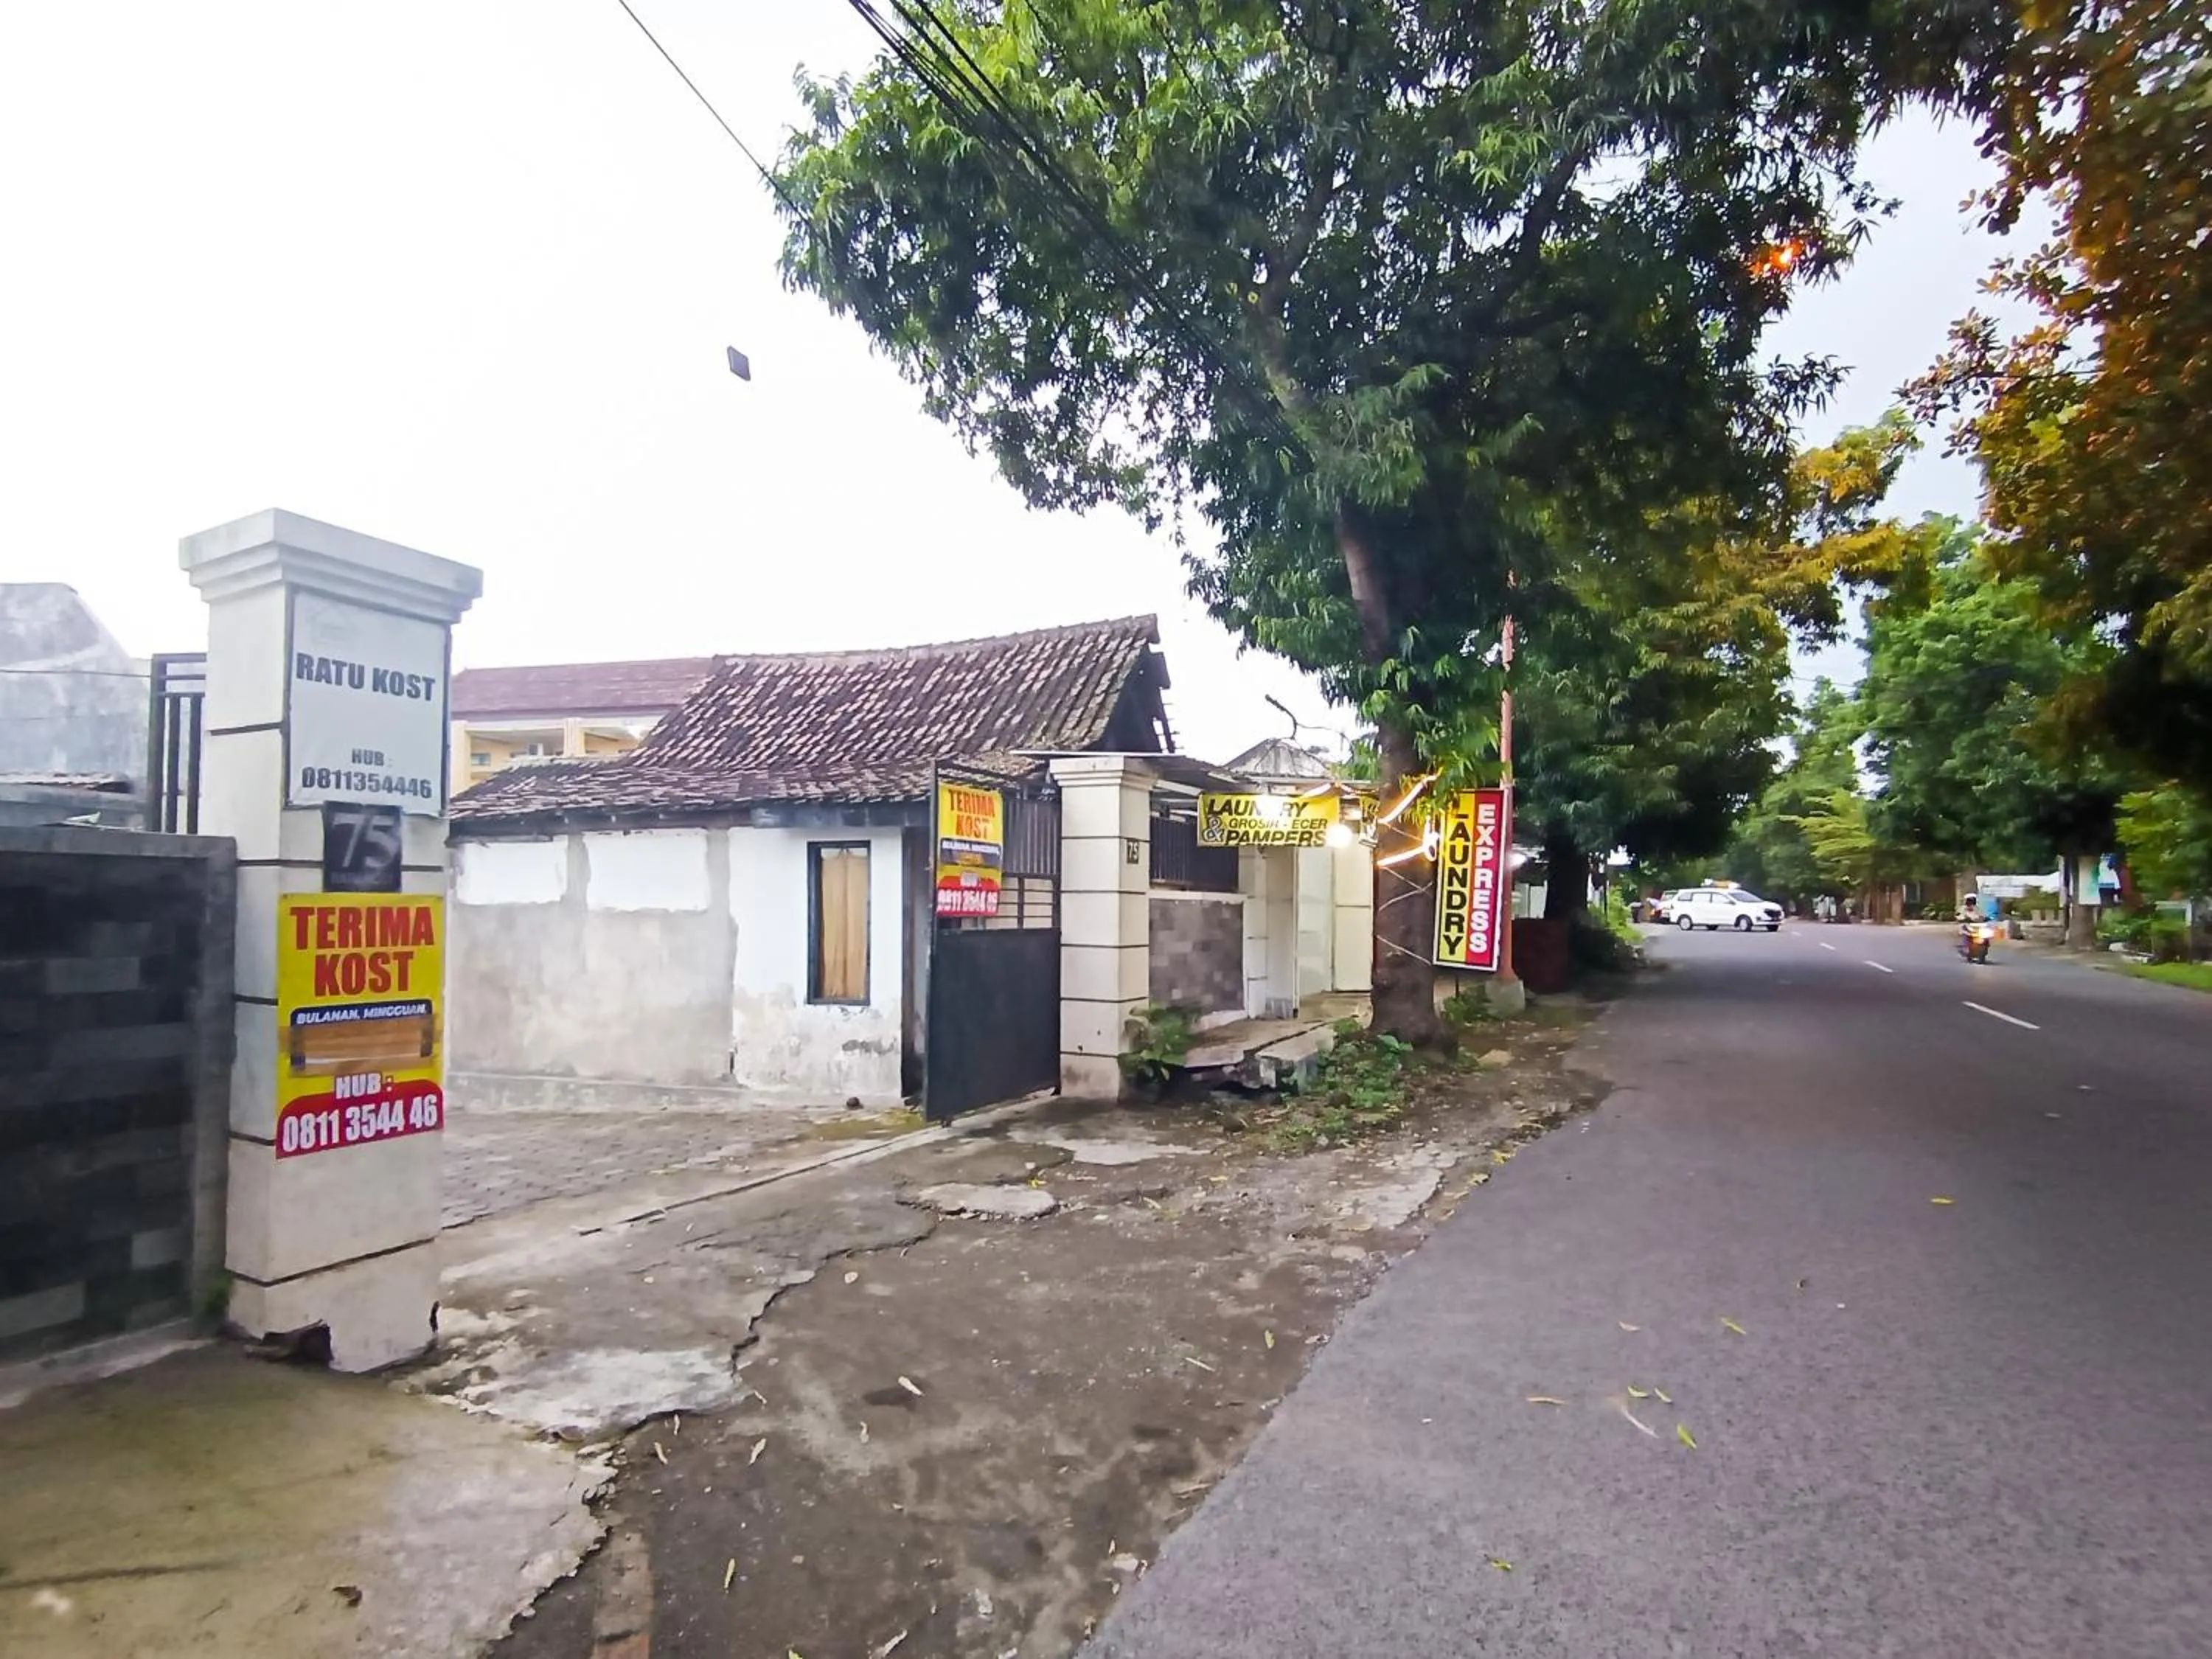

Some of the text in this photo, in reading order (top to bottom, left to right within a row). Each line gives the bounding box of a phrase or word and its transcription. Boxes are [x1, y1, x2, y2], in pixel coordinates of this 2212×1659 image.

[296, 652, 436, 701] RATU KOST
[351, 748, 385, 766] HUB
[301, 766, 433, 799] 0811354446
[947, 789, 995, 818] TERIMA
[331, 811, 400, 869] 75
[955, 814, 990, 839] KOST
[1225, 830, 1327, 847] PAMPERS
[1291, 818, 1328, 830] ECER
[1469, 802, 1496, 953] EXPRESS
[290, 906, 435, 951] TERIMA
[313, 951, 414, 998] KOST
[335, 1073, 382, 1099] HUB
[282, 1094, 438, 1152] 0811 3544 46
